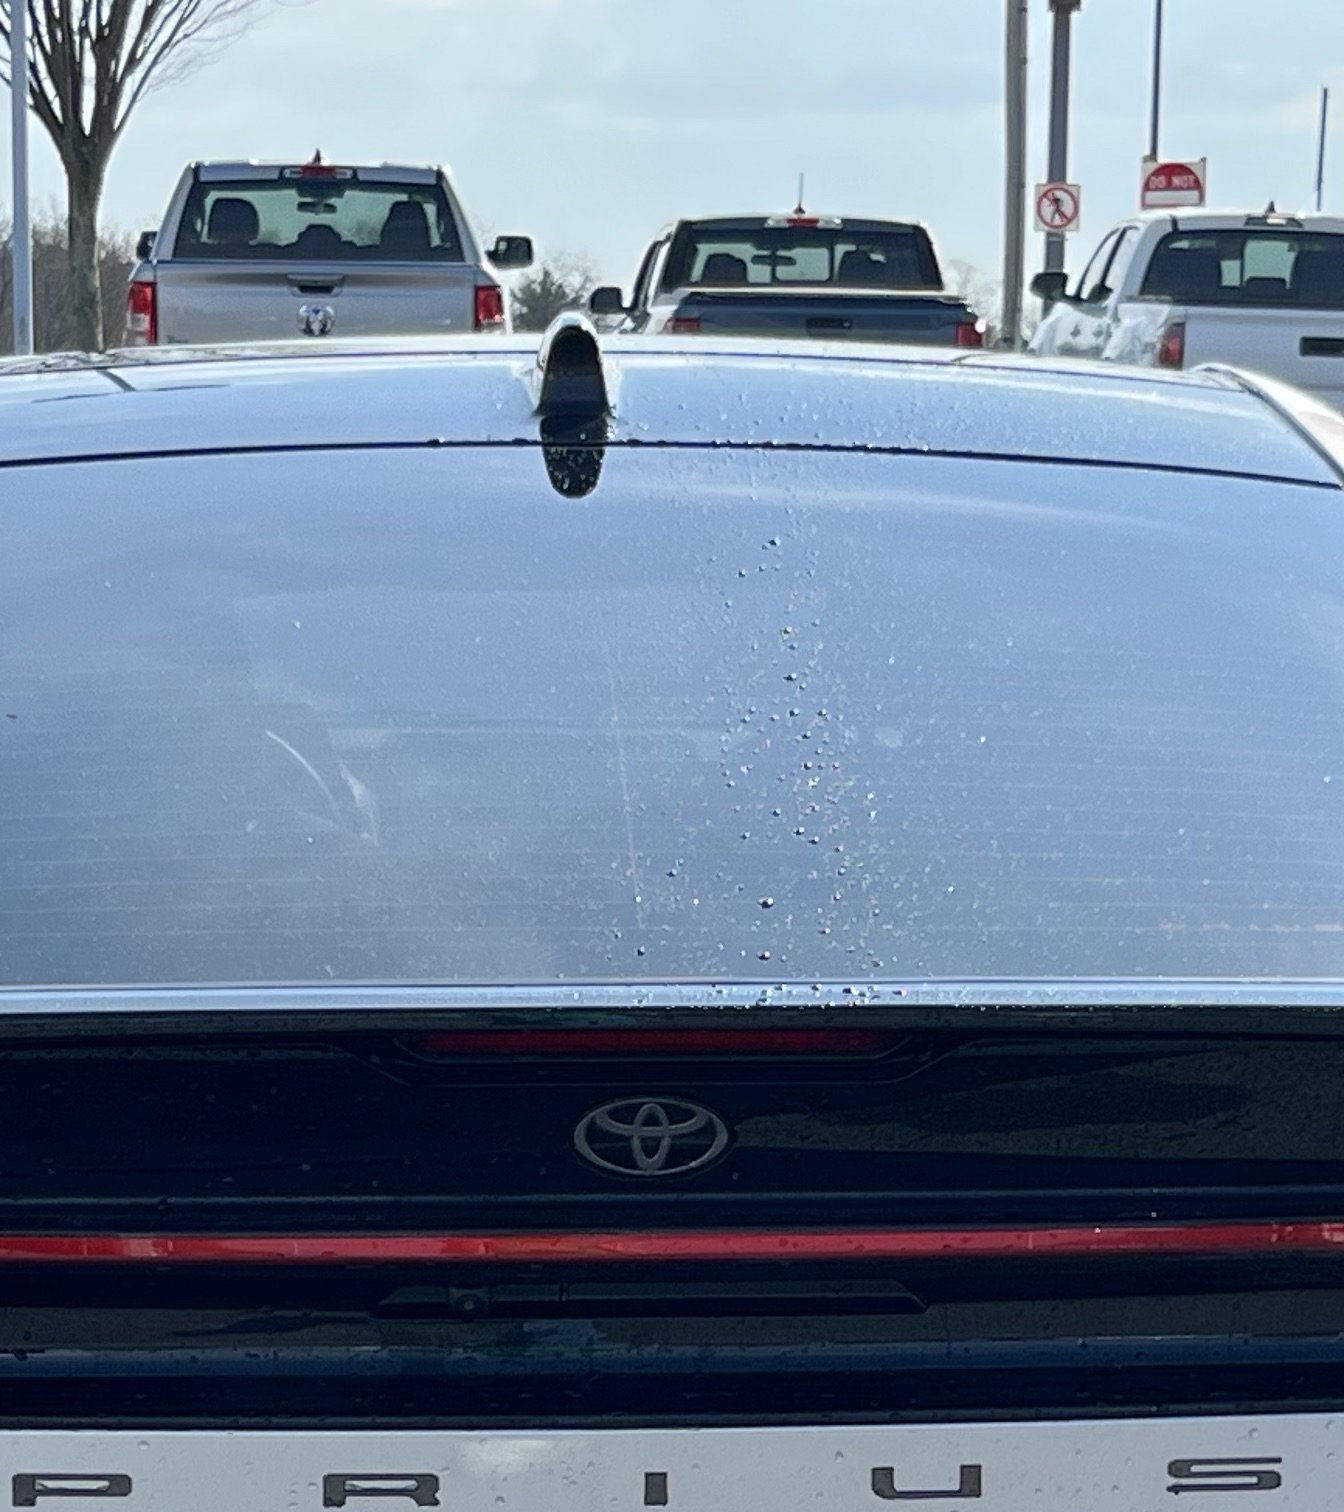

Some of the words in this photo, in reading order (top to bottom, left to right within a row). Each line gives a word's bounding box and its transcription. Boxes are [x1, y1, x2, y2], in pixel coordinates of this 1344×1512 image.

[1148, 176, 1166, 188] DO
[1171, 175, 1195, 188] NOT
[12, 1457, 1282, 1507] PRIUS
